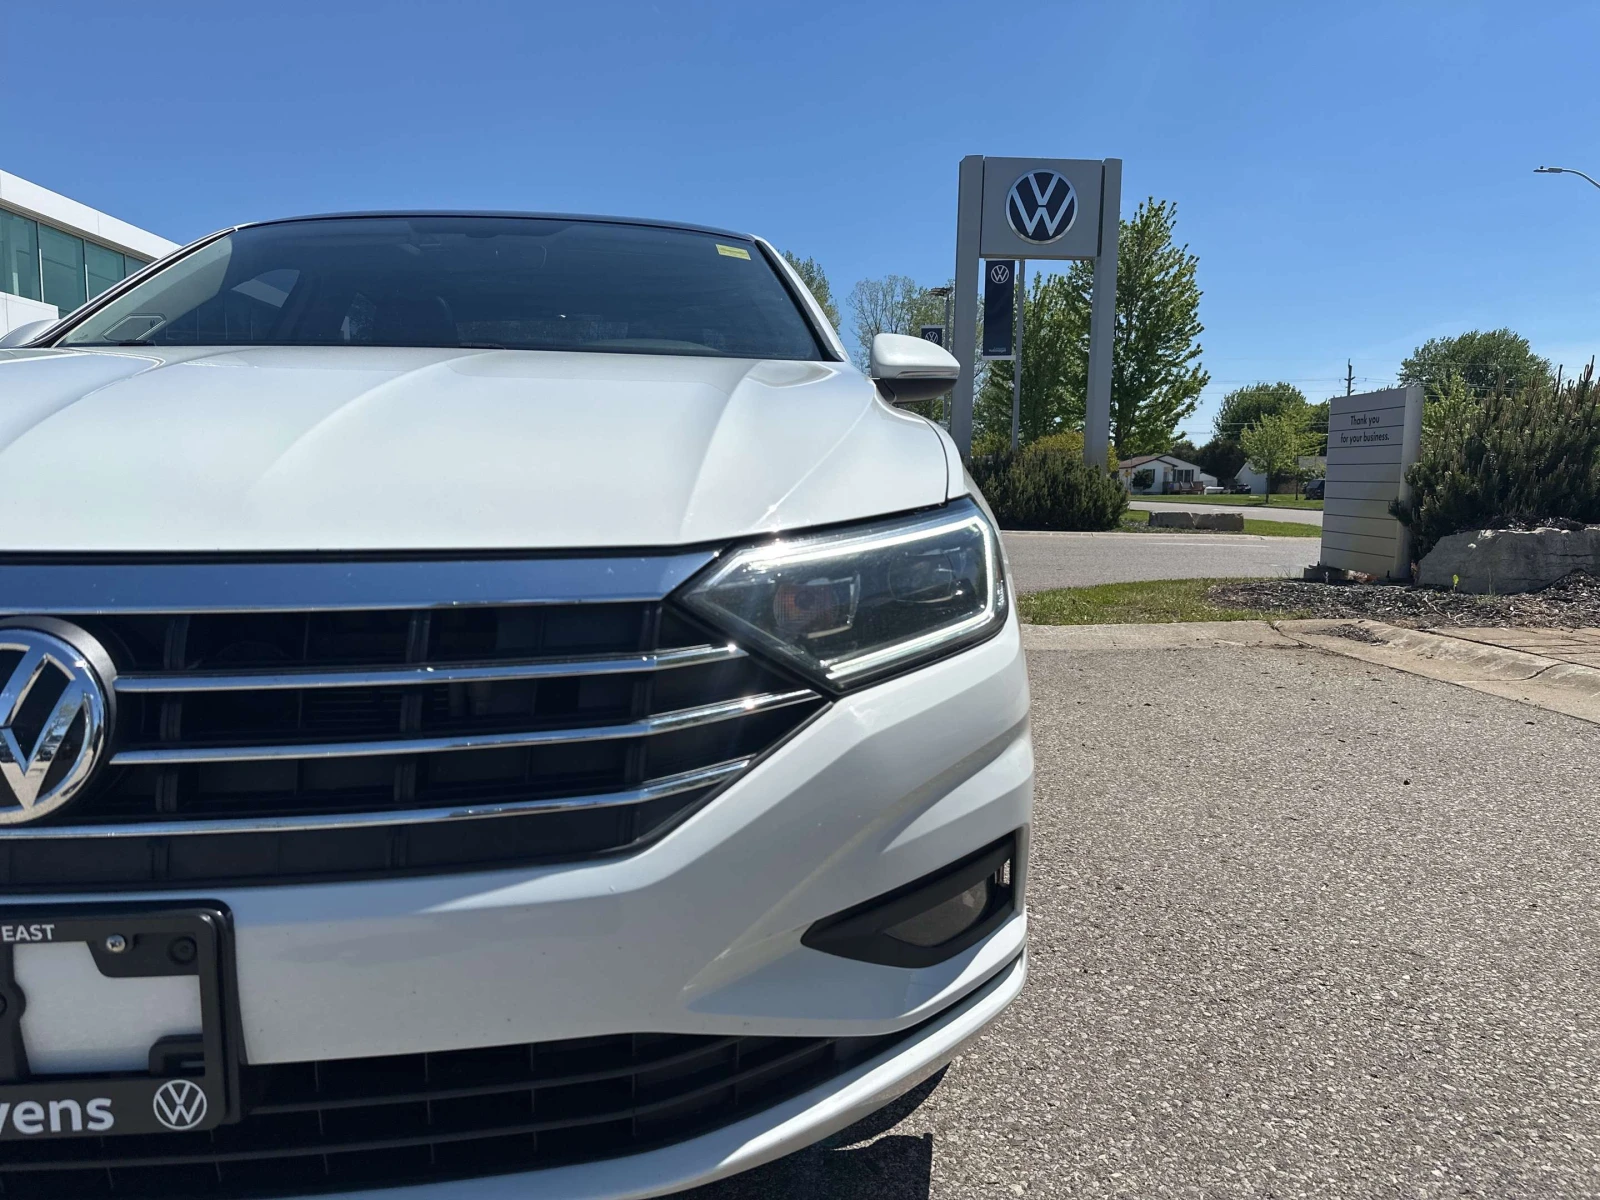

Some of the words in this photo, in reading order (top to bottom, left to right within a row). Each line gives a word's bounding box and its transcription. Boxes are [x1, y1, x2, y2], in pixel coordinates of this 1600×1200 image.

[1007, 170, 1077, 244] VW
[1350, 414, 1367, 426] Thank
[1368, 415, 1380, 426] you
[1340, 432, 1349, 443] for
[1349, 435, 1362, 445] your
[1363, 431, 1390, 442] business.
[1, 924, 55, 941] EAST
[153, 1079, 207, 1130] VW
